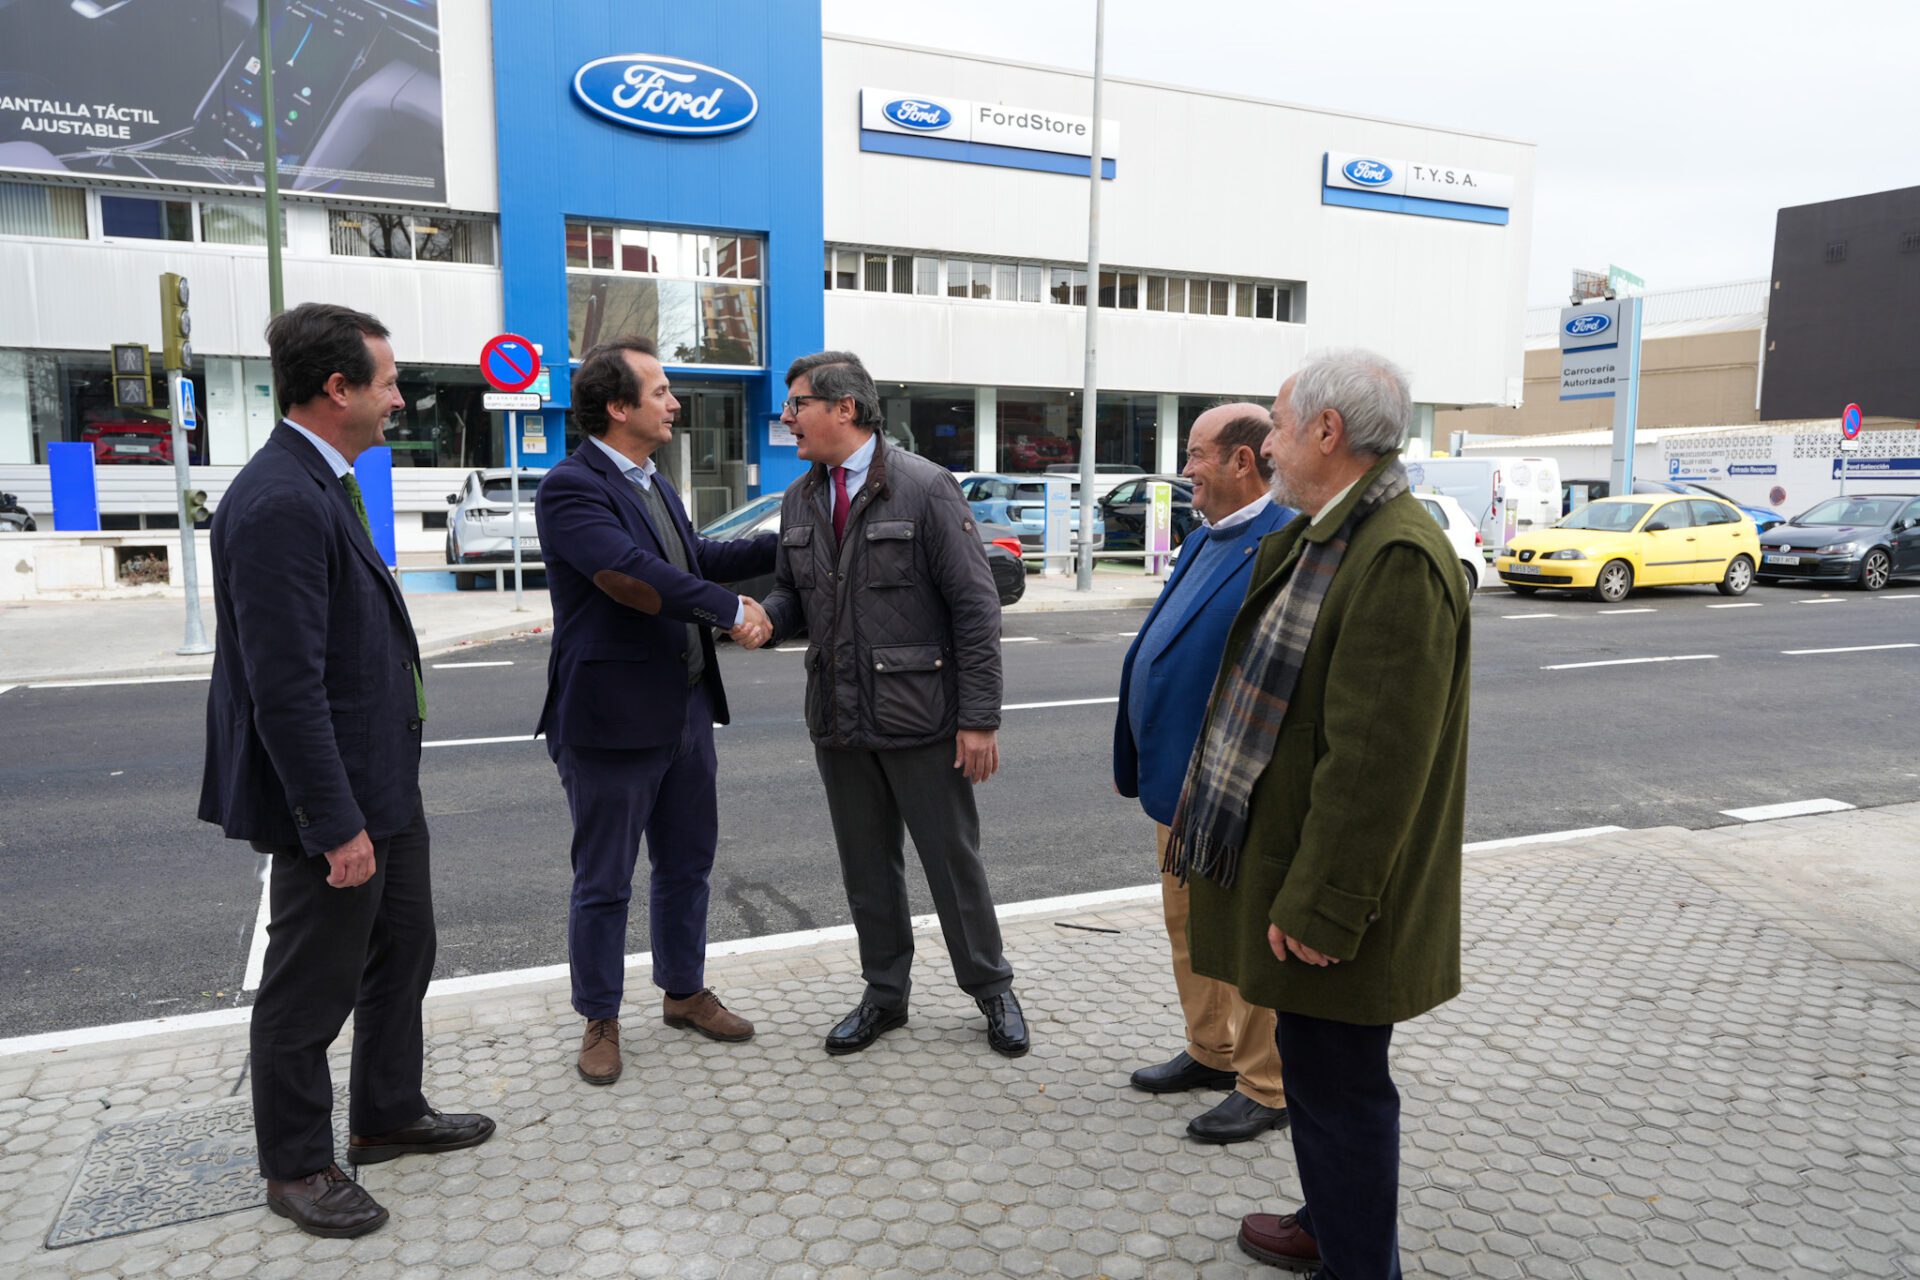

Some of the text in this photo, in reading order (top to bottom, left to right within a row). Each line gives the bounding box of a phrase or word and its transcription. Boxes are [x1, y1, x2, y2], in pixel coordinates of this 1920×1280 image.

[611, 64, 724, 121] Ford
[0, 95, 160, 125] ANTALLA TÁCTIL
[896, 100, 941, 125] Ford
[20, 116, 132, 140] AJUSTABLE
[979, 107, 1087, 136] FordStore
[1352, 160, 1386, 181] Ford
[1572, 316, 1601, 333] Ford
[1563, 376, 1616, 388] Autorizada
[1750, 465, 1776, 474] Recepción
[1860, 463, 1890, 471] Selección
